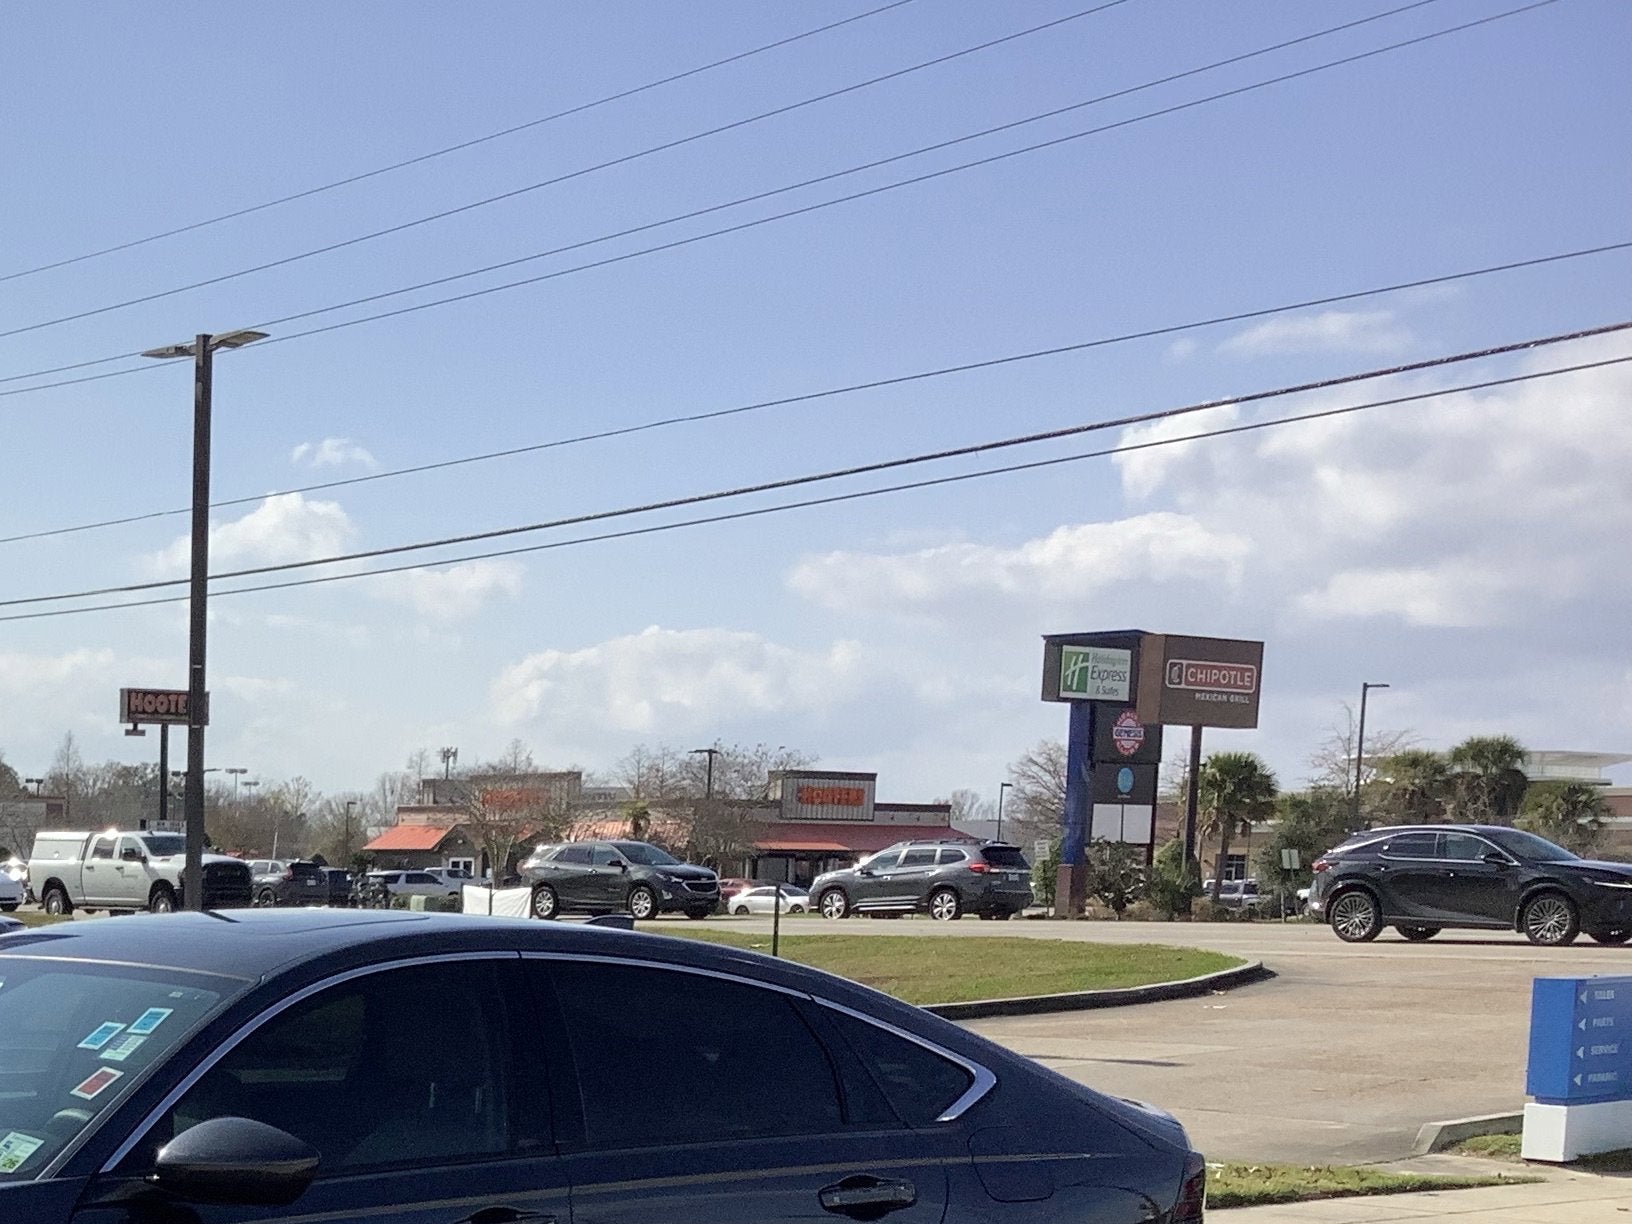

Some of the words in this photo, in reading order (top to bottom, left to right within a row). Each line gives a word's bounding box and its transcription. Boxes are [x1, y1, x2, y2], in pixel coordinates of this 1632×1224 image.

[1090, 665, 1128, 684] Express
[1188, 667, 1252, 686] CHIPOTLE
[129, 692, 188, 714] HOOTE
[1195, 692, 1227, 702] MEXICAN
[1229, 694, 1250, 704] GRILL
[1593, 1017, 1614, 1026] PARTS
[1590, 1045, 1618, 1055] SERVICE
